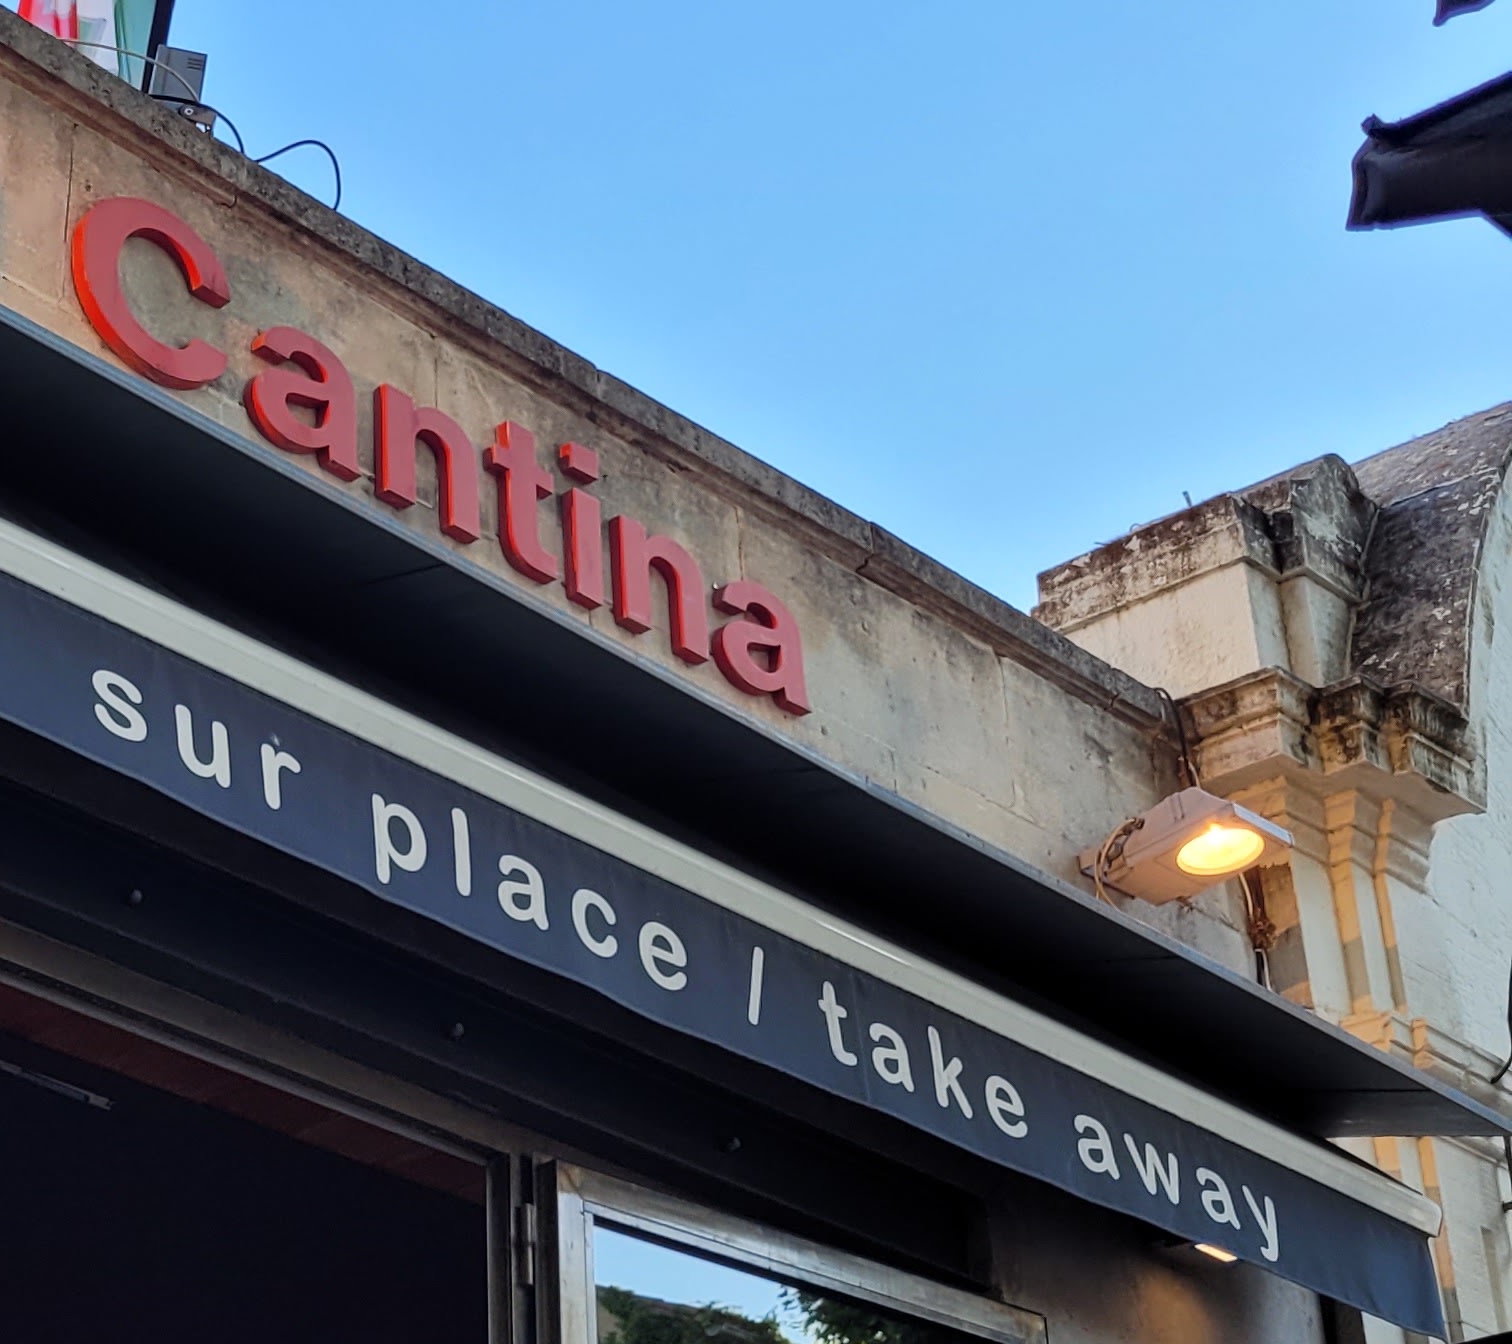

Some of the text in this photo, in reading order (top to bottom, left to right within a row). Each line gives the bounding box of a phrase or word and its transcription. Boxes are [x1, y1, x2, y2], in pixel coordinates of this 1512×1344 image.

[71, 196, 812, 716] Cantina
[91, 668, 302, 810] sur
[371, 792, 688, 991] place
[817, 980, 1029, 1140] take
[1073, 1112, 1280, 1263] away
